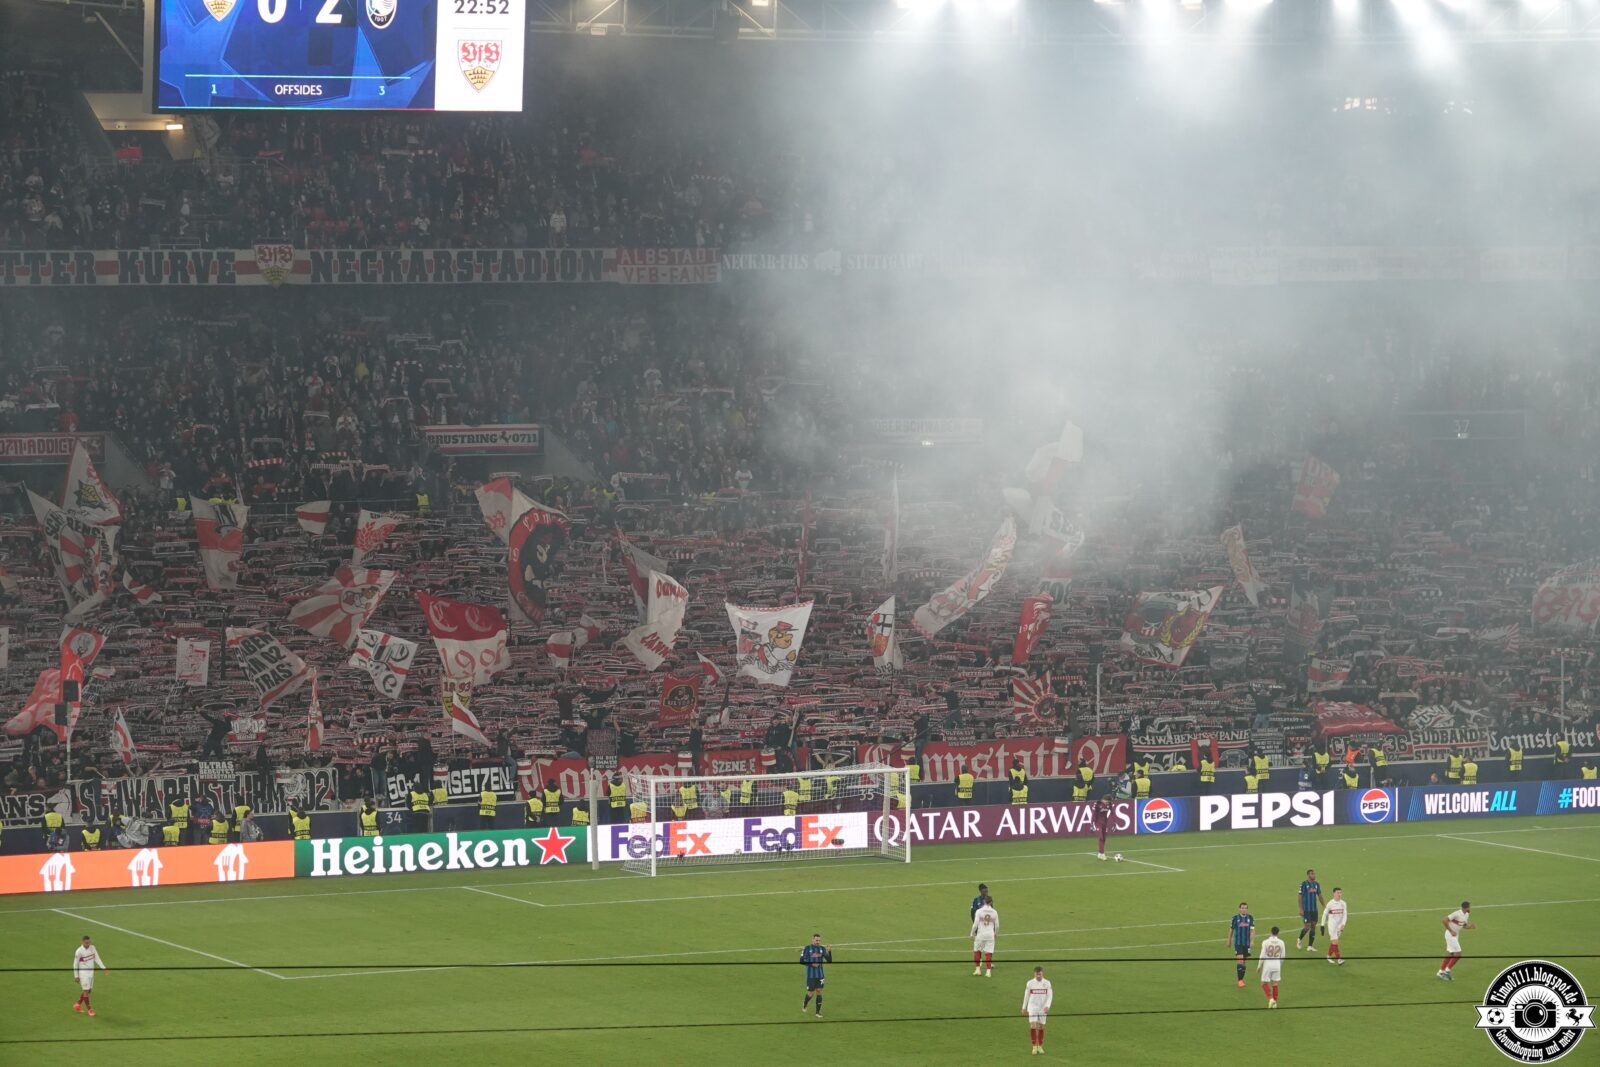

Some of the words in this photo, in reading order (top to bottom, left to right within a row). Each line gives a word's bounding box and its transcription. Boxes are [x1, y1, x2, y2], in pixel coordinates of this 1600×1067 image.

[315, 0, 343, 24] 2
[454, 0, 510, 15] 22:52
[211, 84, 217, 94] 1
[275, 84, 322, 96] OFFSIDES
[379, 86, 386, 95] 3
[118, 251, 236, 284] KURVE
[310, 250, 601, 282] NECKARSTADION
[625, 266, 718, 281] VFB-FANS
[1453, 419, 1471, 433] 37
[427, 433, 498, 445] BRUSTRING
[512, 433, 537, 443] 0711
[261, 645, 287, 664] 02
[199, 761, 234, 769] ULTRAS
[712, 760, 746, 774] SZENE
[1078, 739, 1120, 777] 97
[1199, 790, 1335, 831] PEPSI
[1362, 802, 1389, 810] PEPSI
[1424, 791, 1489, 815] WELCOME
[1490, 790, 1517, 812] ALL
[386, 812, 401, 824] 34
[1144, 812, 1172, 821] PEPSI
[743, 815, 843, 852] FedEx
[872, 809, 982, 847] QATAR
[610, 821, 712, 859] FedEx
[310, 832, 530, 877] Heineken
